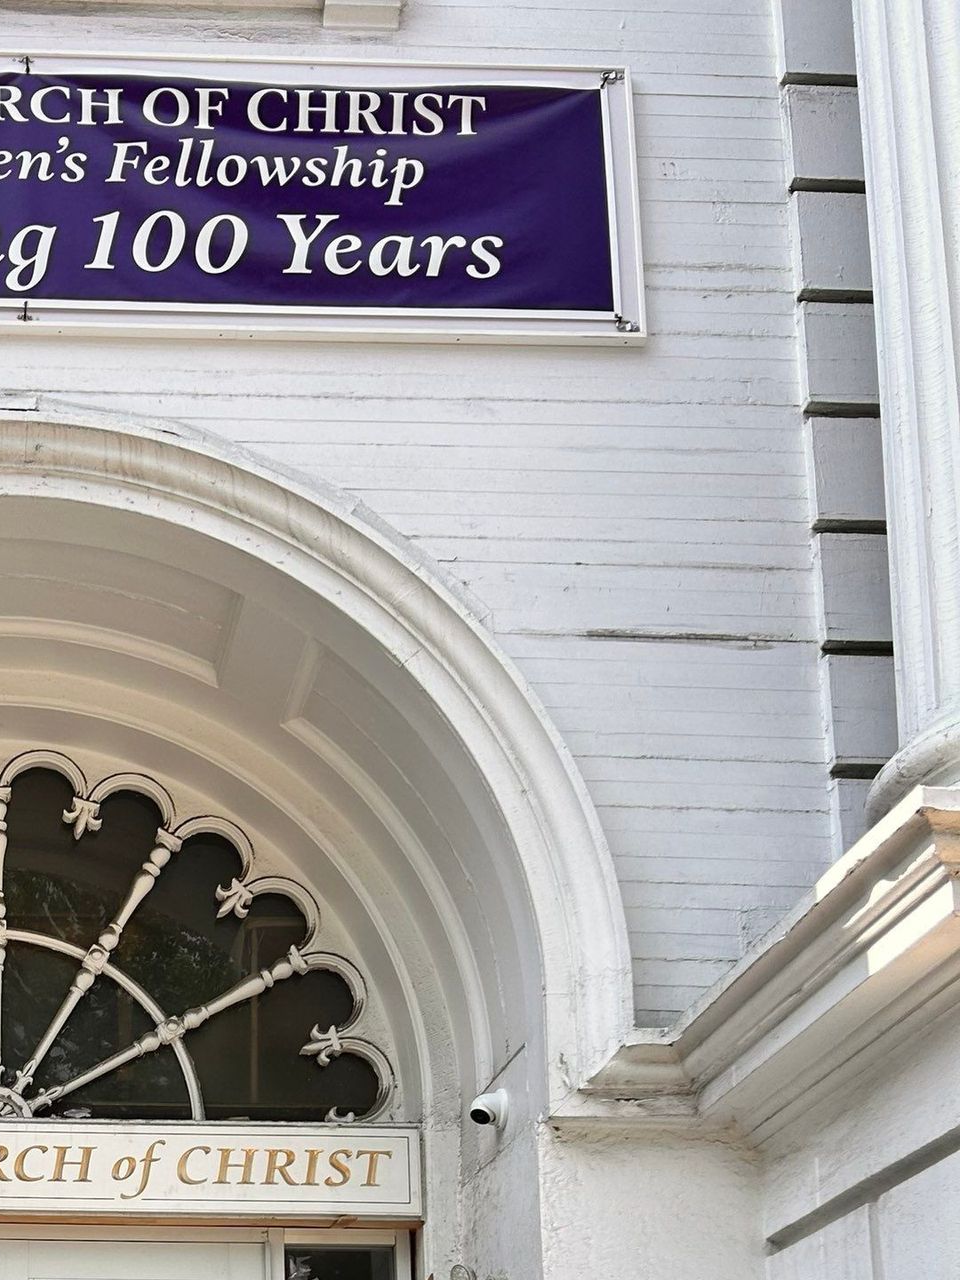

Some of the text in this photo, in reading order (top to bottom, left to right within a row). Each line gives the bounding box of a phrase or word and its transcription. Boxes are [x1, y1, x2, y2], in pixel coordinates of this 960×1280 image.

[142, 87, 229, 130] OF
[247, 88, 486, 136] CHRIST
[104, 138, 424, 206] Fellowship
[83, 210, 249, 274] 100
[276, 214, 504, 279] Years
[111, 1140, 165, 1199] of
[176, 1145, 394, 1187] CHRIST
